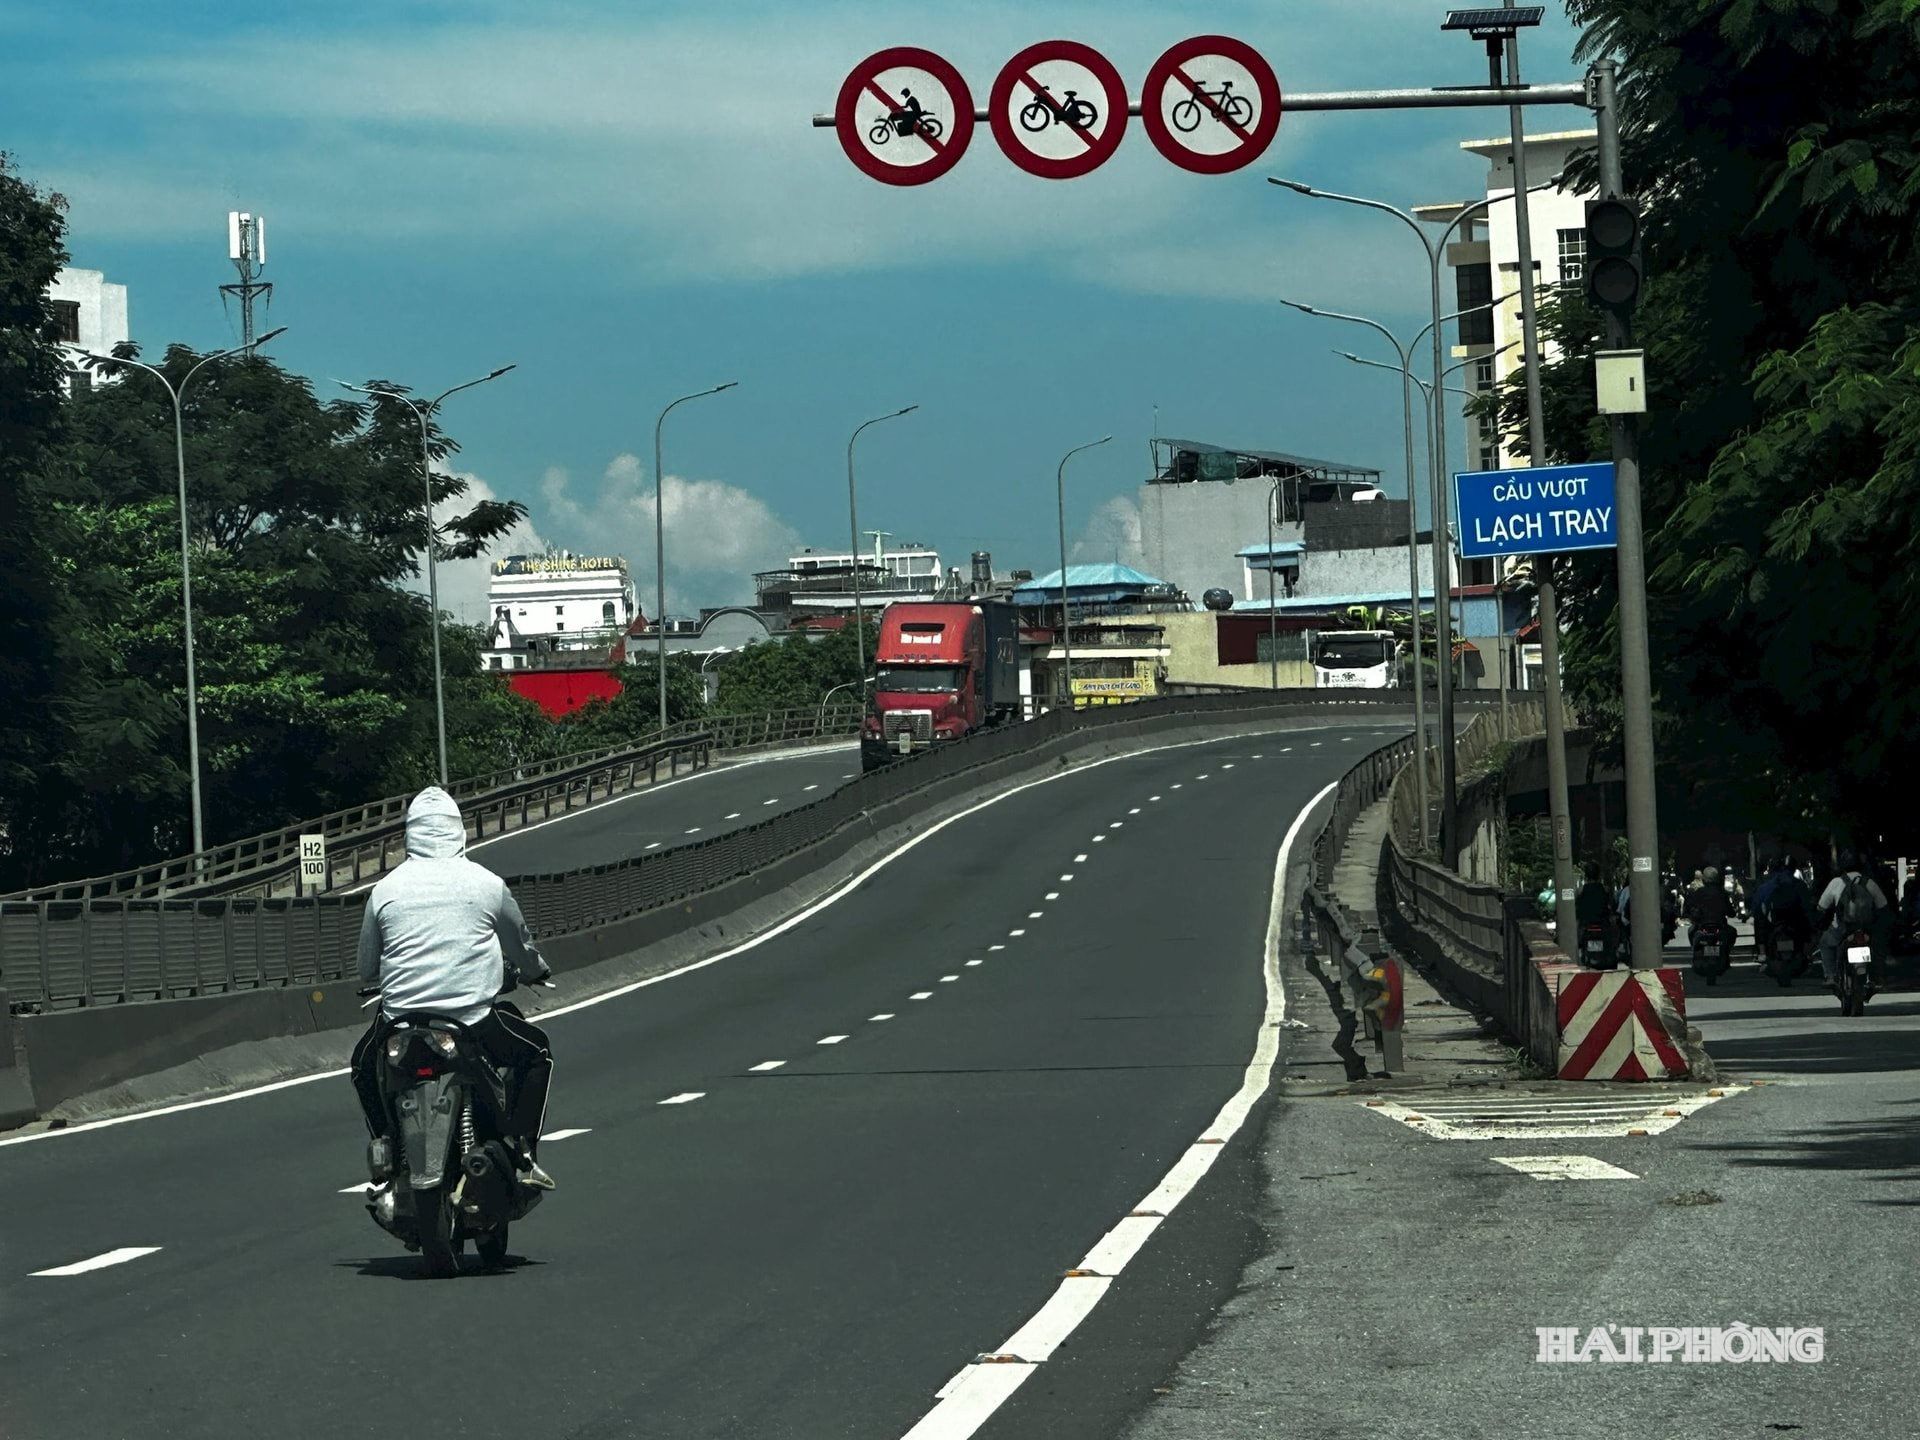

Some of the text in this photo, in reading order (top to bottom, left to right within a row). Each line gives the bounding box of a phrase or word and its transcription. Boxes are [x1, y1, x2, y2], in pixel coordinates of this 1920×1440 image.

[1493, 476, 1589, 502] CẦU VƯỢT
[1475, 506, 1612, 547] LẠCH TRAY
[580, 557, 614, 569] HOTEL
[304, 842, 321, 856] H2
[304, 862, 324, 875] 100
